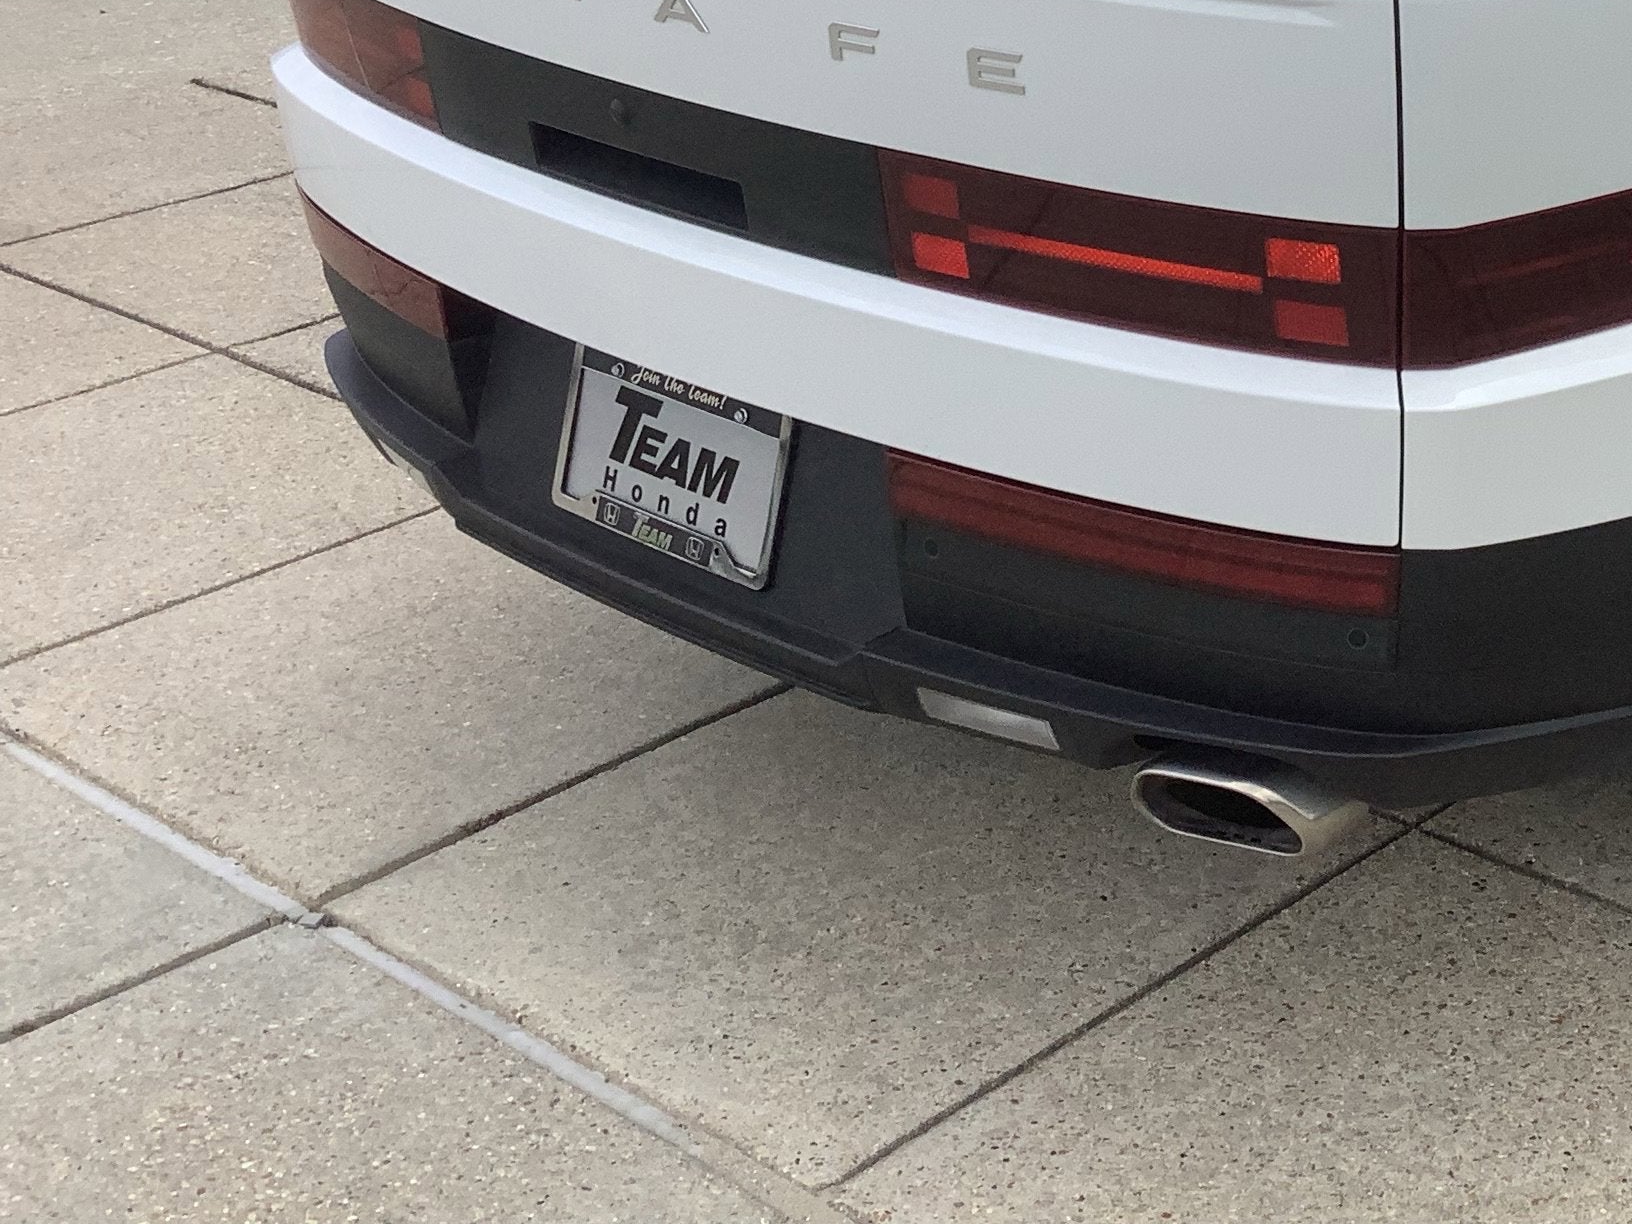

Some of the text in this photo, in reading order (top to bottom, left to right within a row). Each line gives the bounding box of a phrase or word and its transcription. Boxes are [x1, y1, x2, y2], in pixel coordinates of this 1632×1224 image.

[828, 22, 1027, 97] FE
[630, 365, 661, 385] Join
[663, 375, 686, 395] the
[608, 384, 740, 505] TEAM
[602, 465, 728, 539] Honda
[631, 511, 673, 551] TEAM
